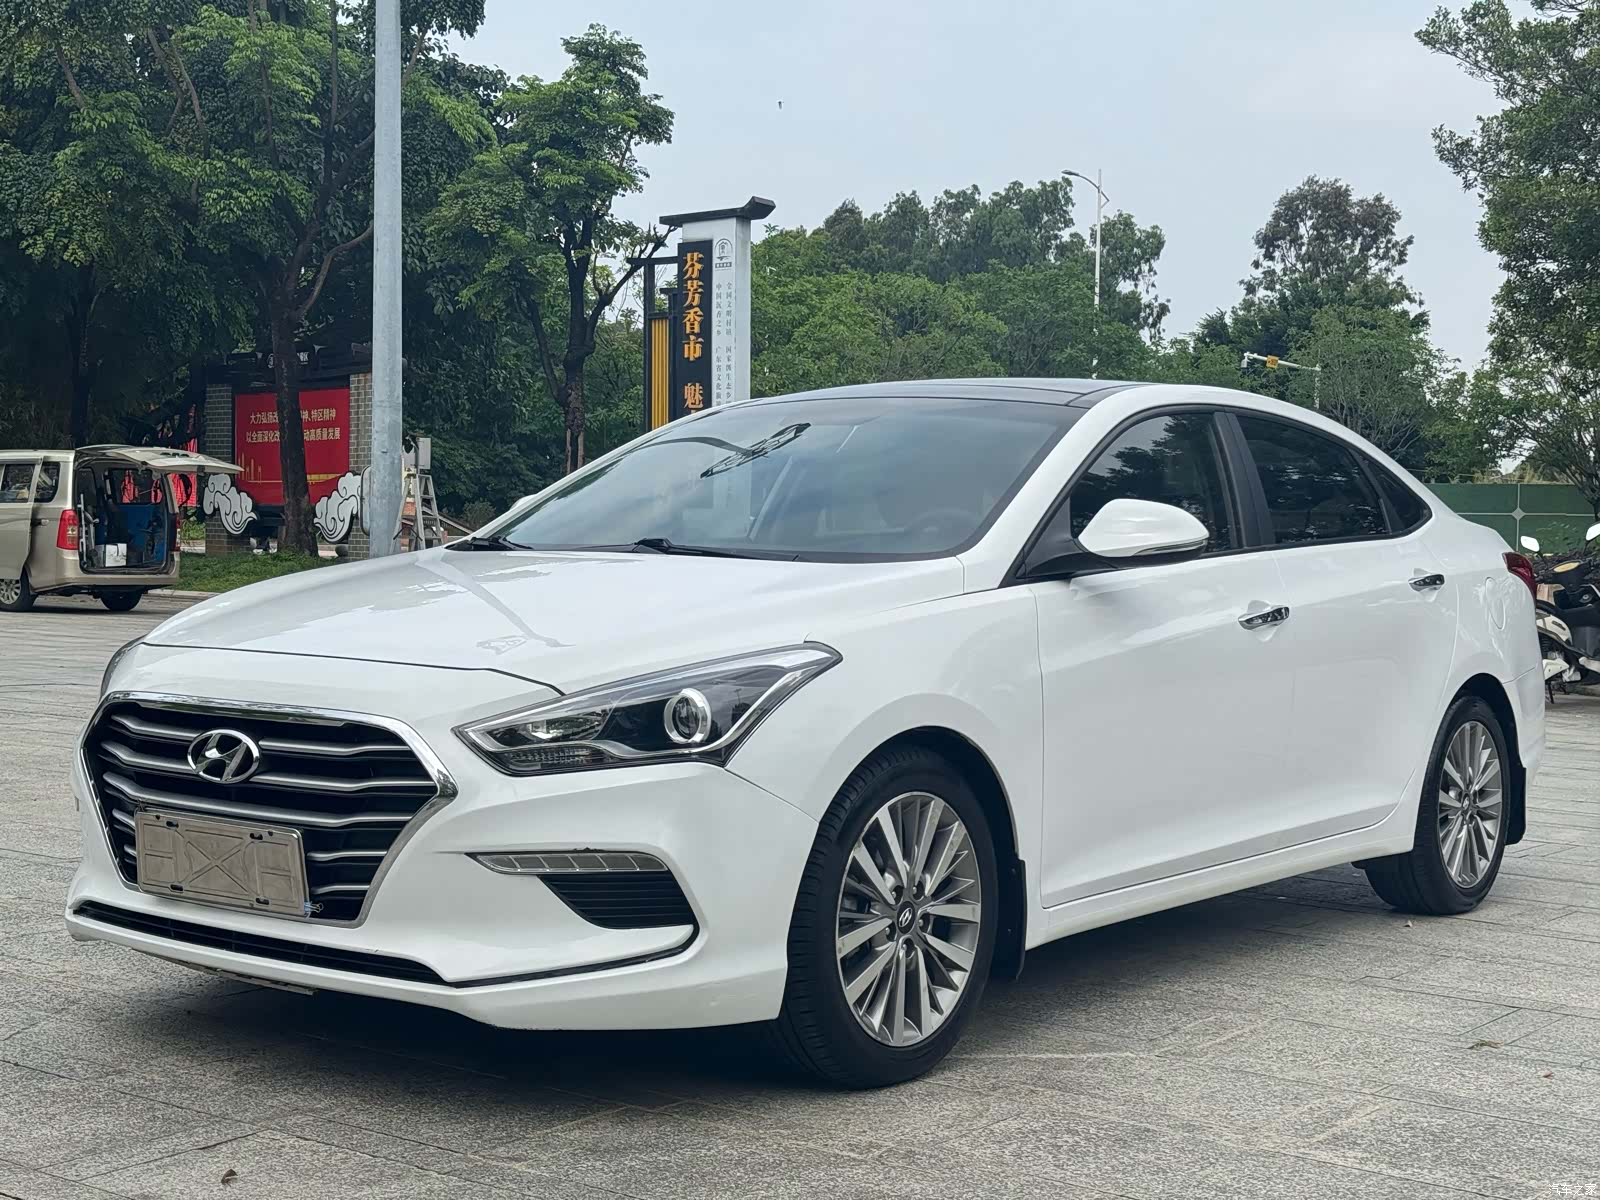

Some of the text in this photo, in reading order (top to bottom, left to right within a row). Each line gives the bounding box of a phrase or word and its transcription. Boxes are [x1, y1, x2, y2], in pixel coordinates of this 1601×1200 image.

[682, 252, 704, 413] 芬芳香市 魅
